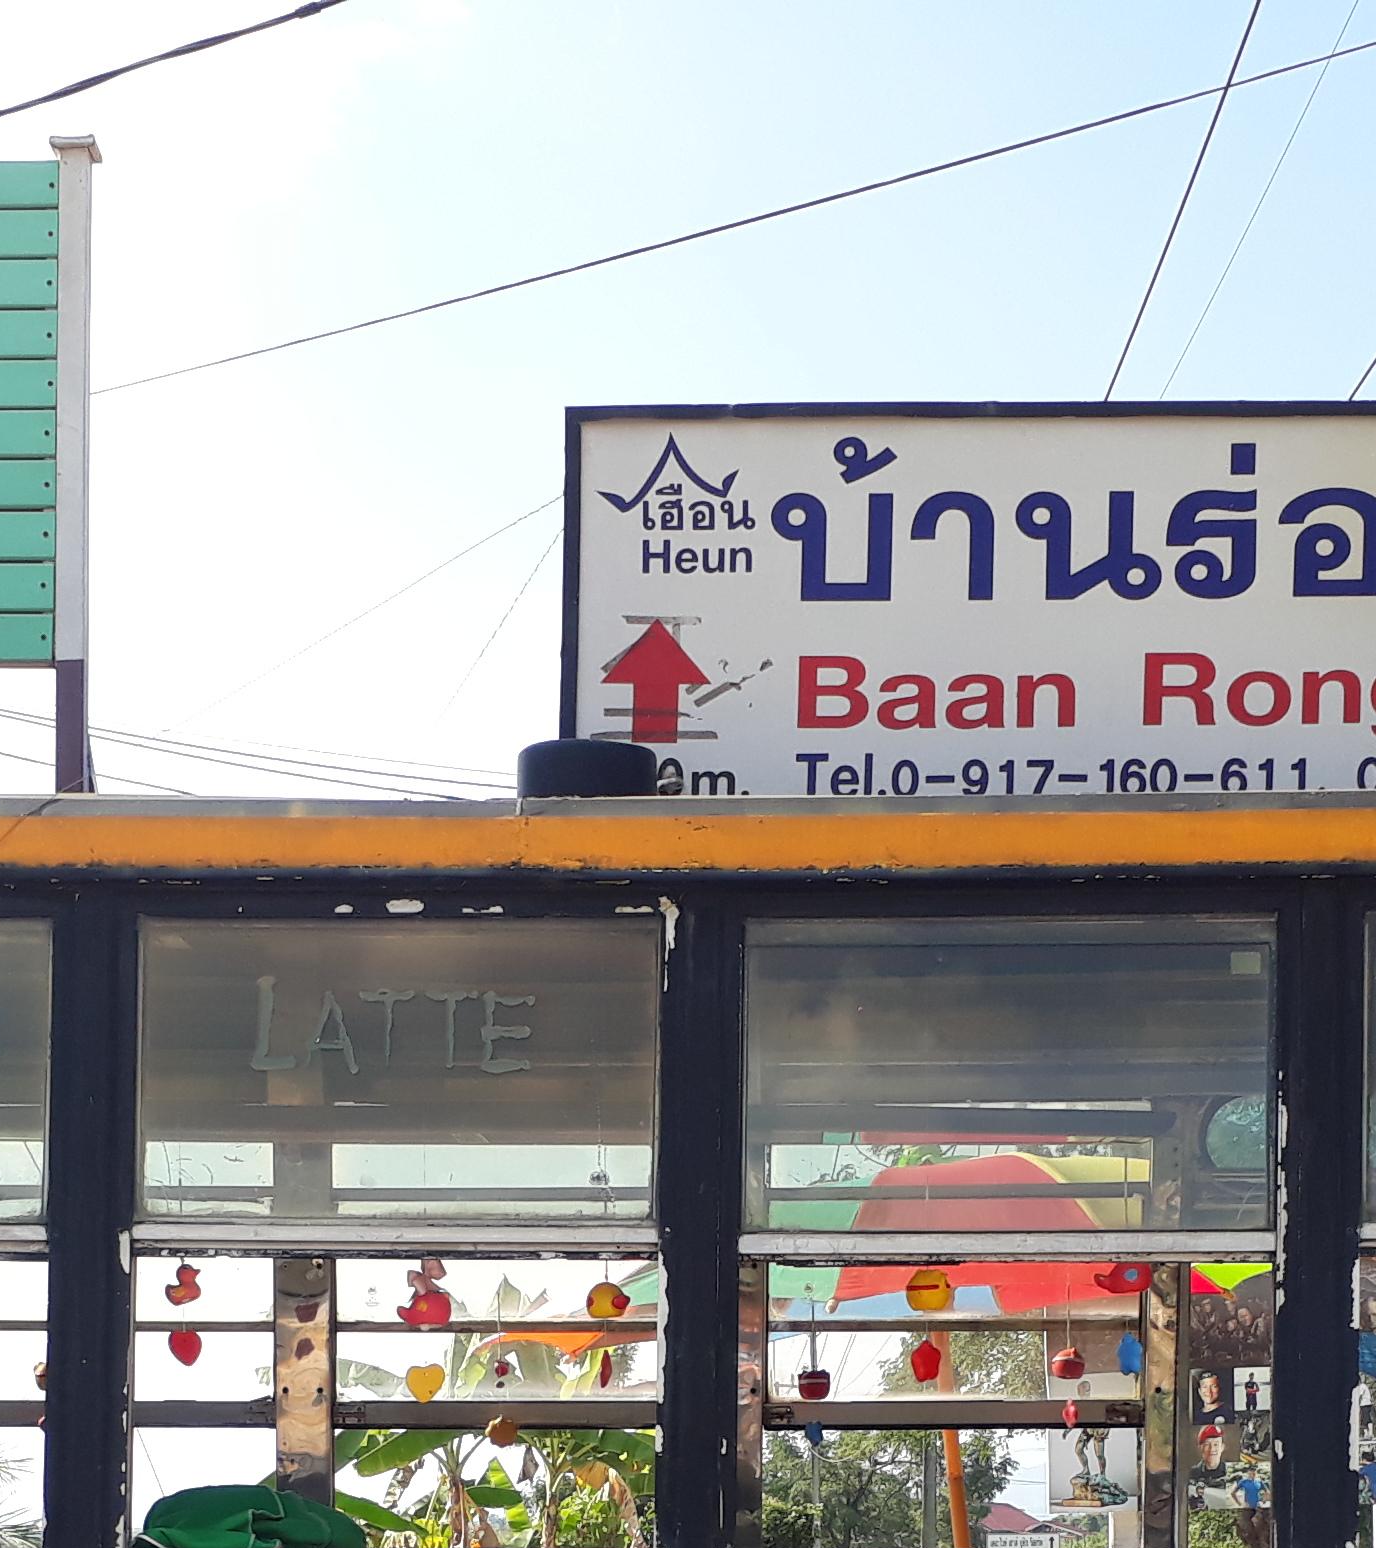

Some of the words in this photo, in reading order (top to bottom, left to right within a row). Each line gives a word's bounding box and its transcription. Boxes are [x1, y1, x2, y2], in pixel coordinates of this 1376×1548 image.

[642, 483, 756, 531] เฮือน
[642, 539, 753, 574] Heun
[796, 655, 1078, 729] Baan
[795, 753, 1325, 796] Tel.0-917-160-611
[249, 974, 538, 1074] LATTE
